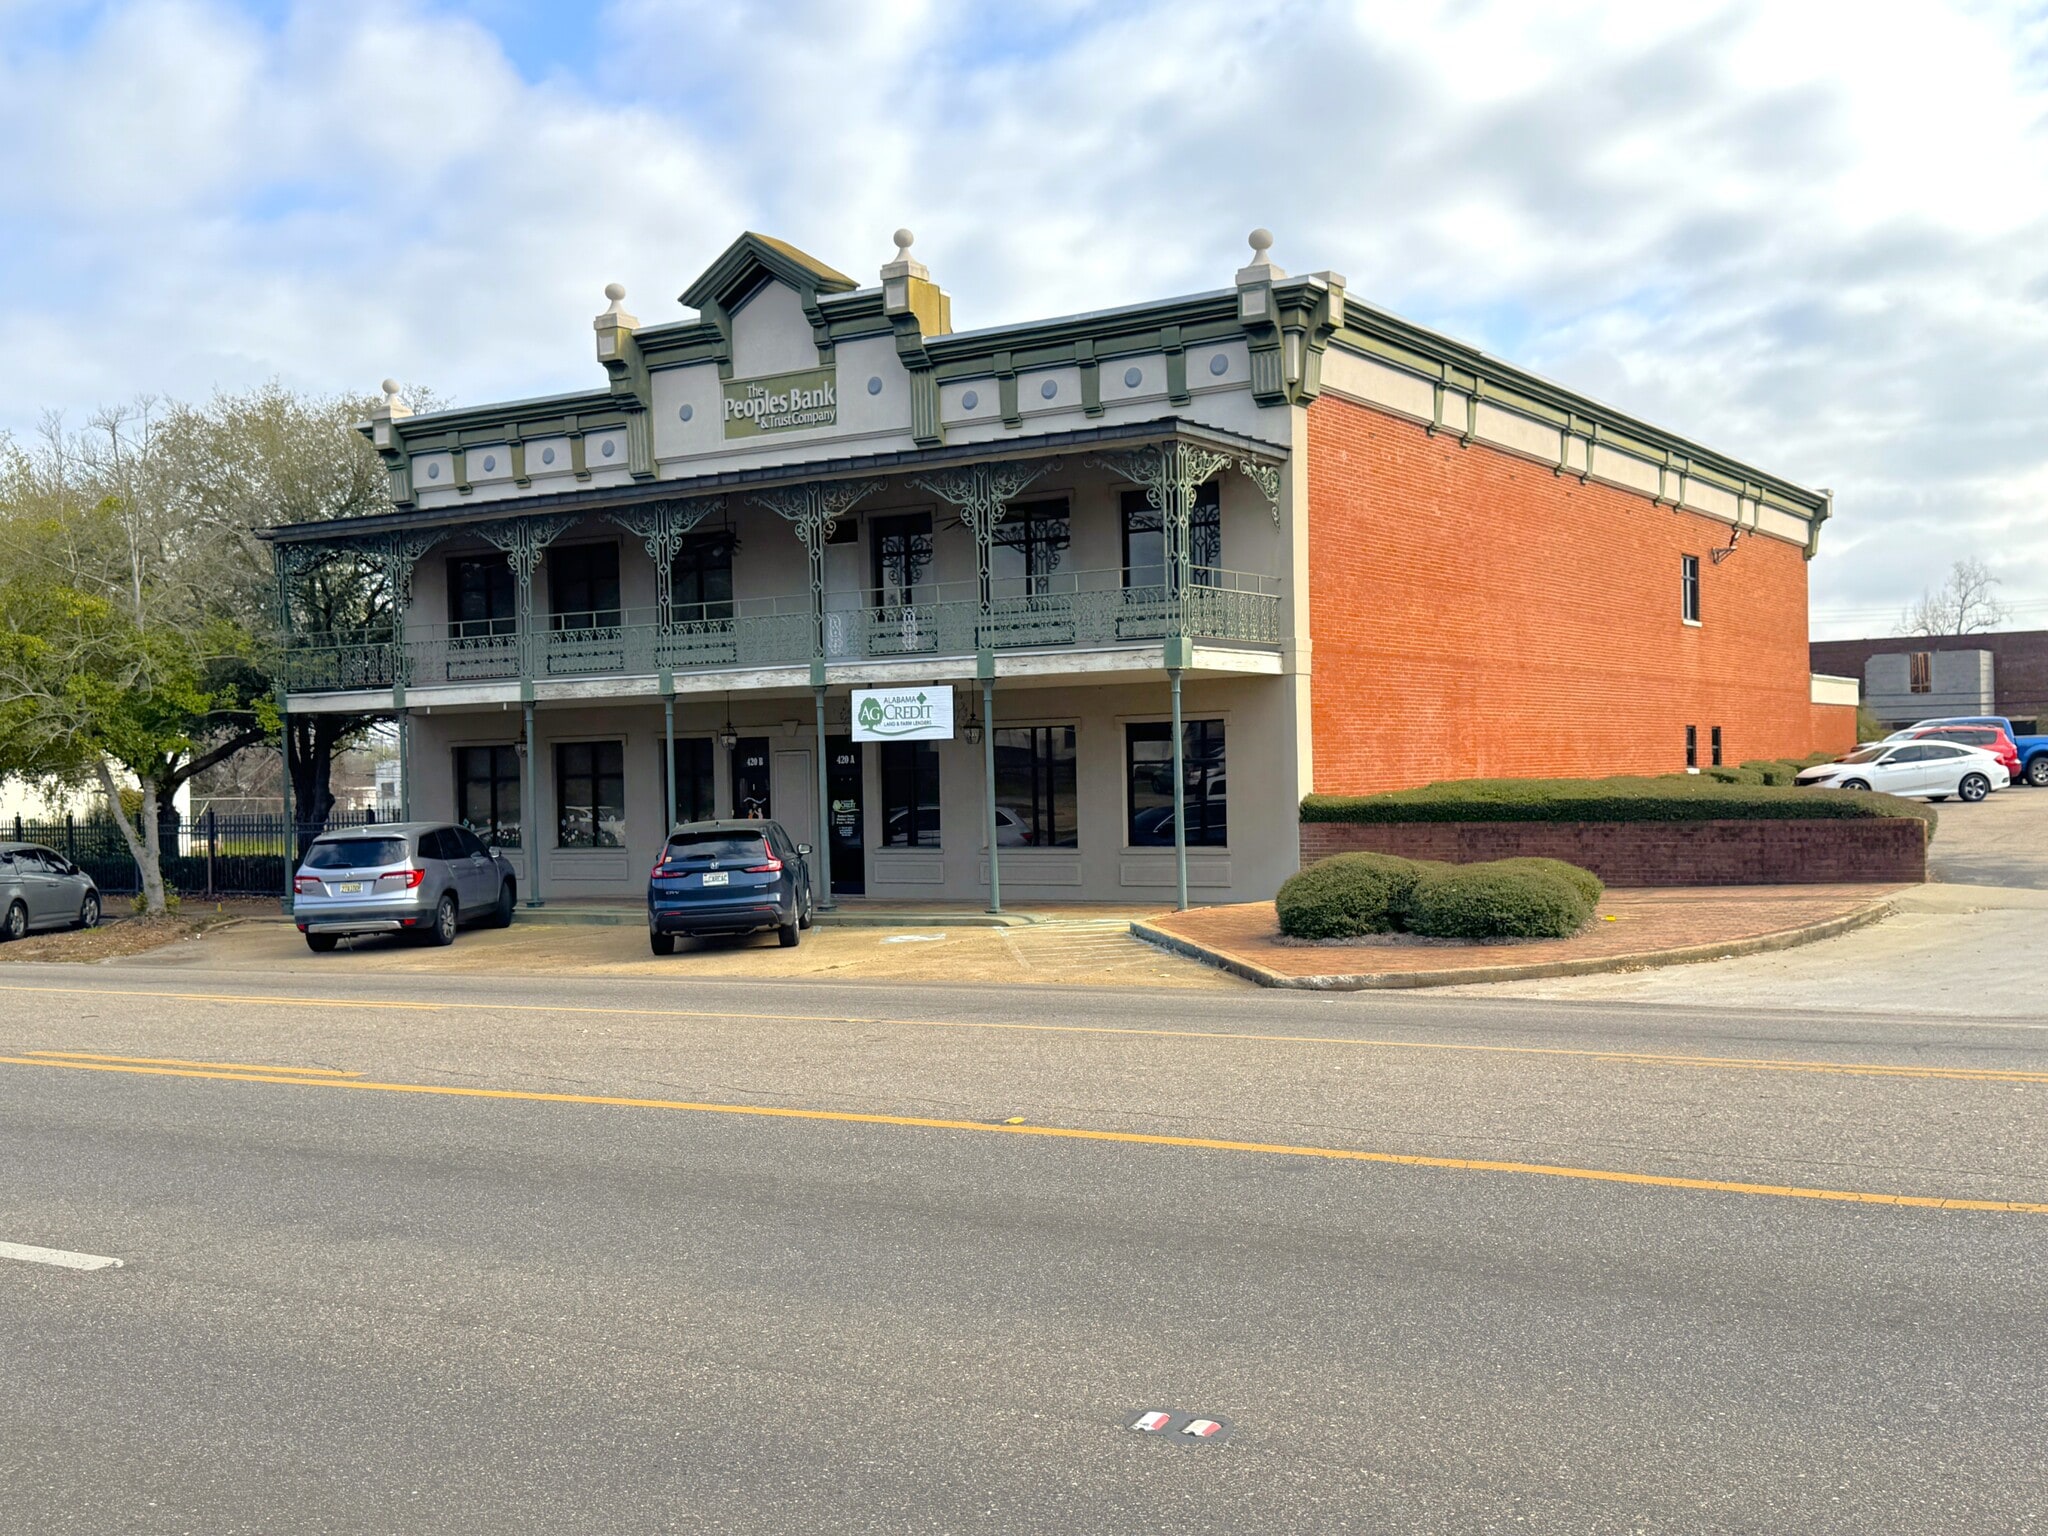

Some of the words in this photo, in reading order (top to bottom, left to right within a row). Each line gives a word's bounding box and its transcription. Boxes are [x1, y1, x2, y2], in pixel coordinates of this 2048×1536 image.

[746, 383, 764, 398] The
[724, 389, 788, 424] Peoples
[790, 381, 836, 412] Bank
[760, 416, 769, 429] &
[769, 414, 792, 428] Trust
[791, 409, 836, 426] Company
[883, 695, 917, 704] ALABAMA
[860, 705, 881, 721] AG
[883, 704, 934, 720] CREDIT
[746, 757, 758, 767] 420
[758, 757, 764, 766] B
[836, 755, 849, 765] 420
[850, 754, 855, 764] A
